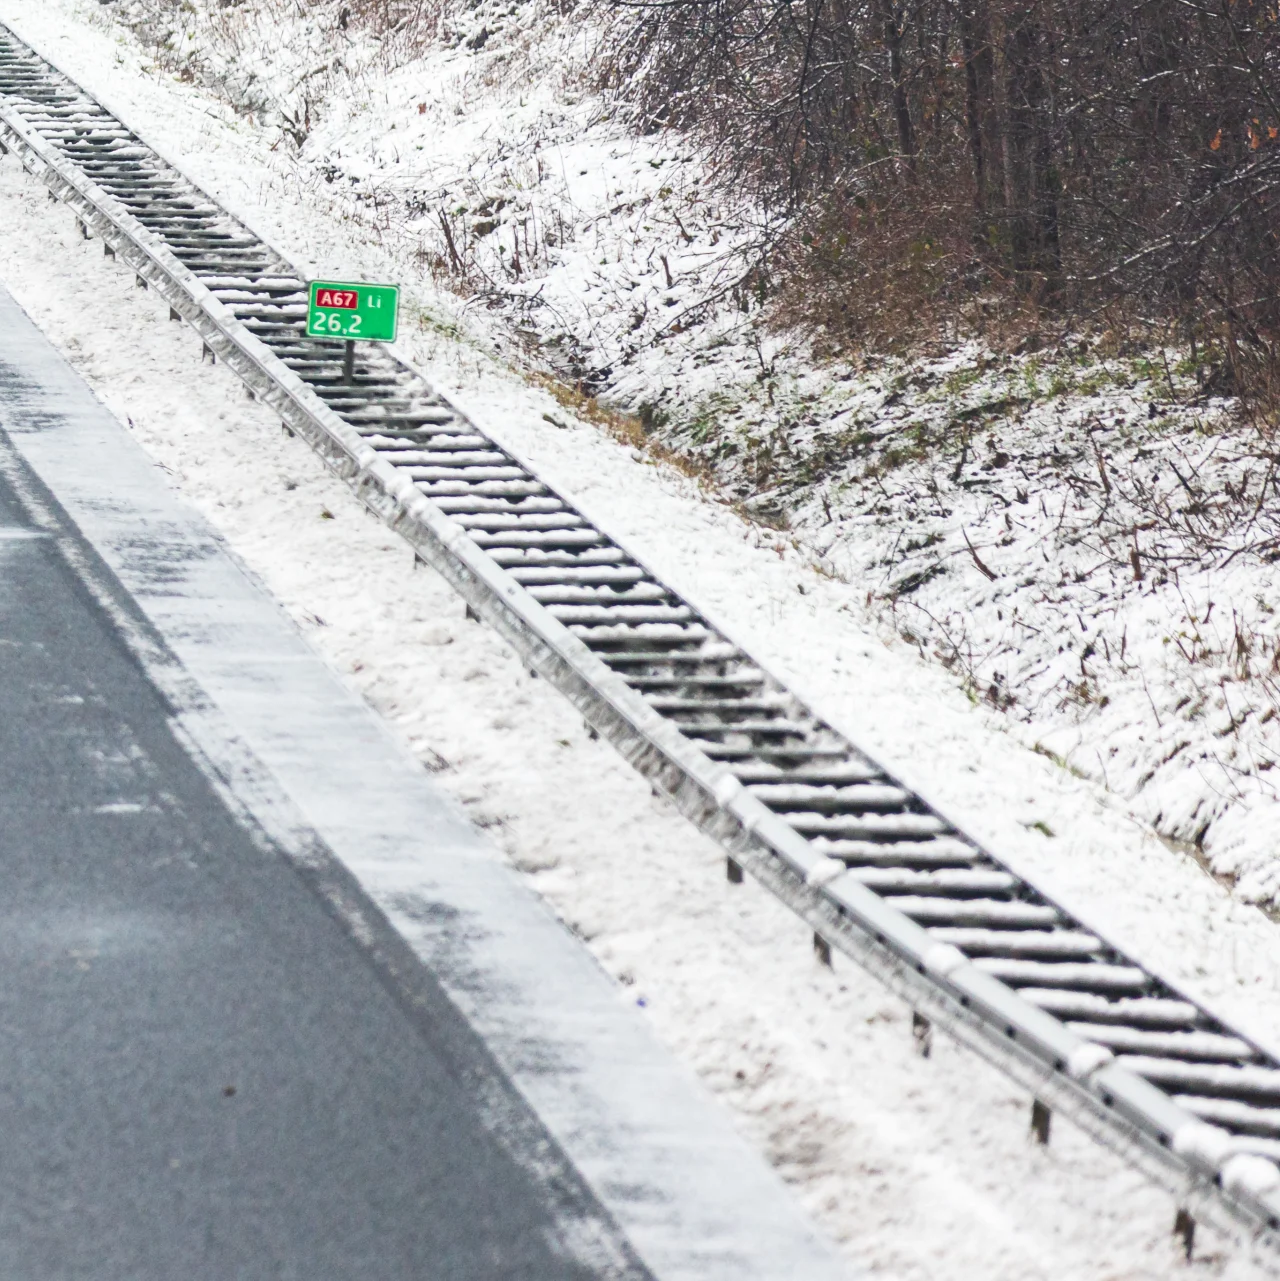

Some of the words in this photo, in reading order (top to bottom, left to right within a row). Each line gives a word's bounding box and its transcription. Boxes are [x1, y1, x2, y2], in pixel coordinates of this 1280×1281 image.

[321, 291, 354, 306] A67
[367, 295, 381, 308] Li
[313, 312, 362, 335] 26,2
